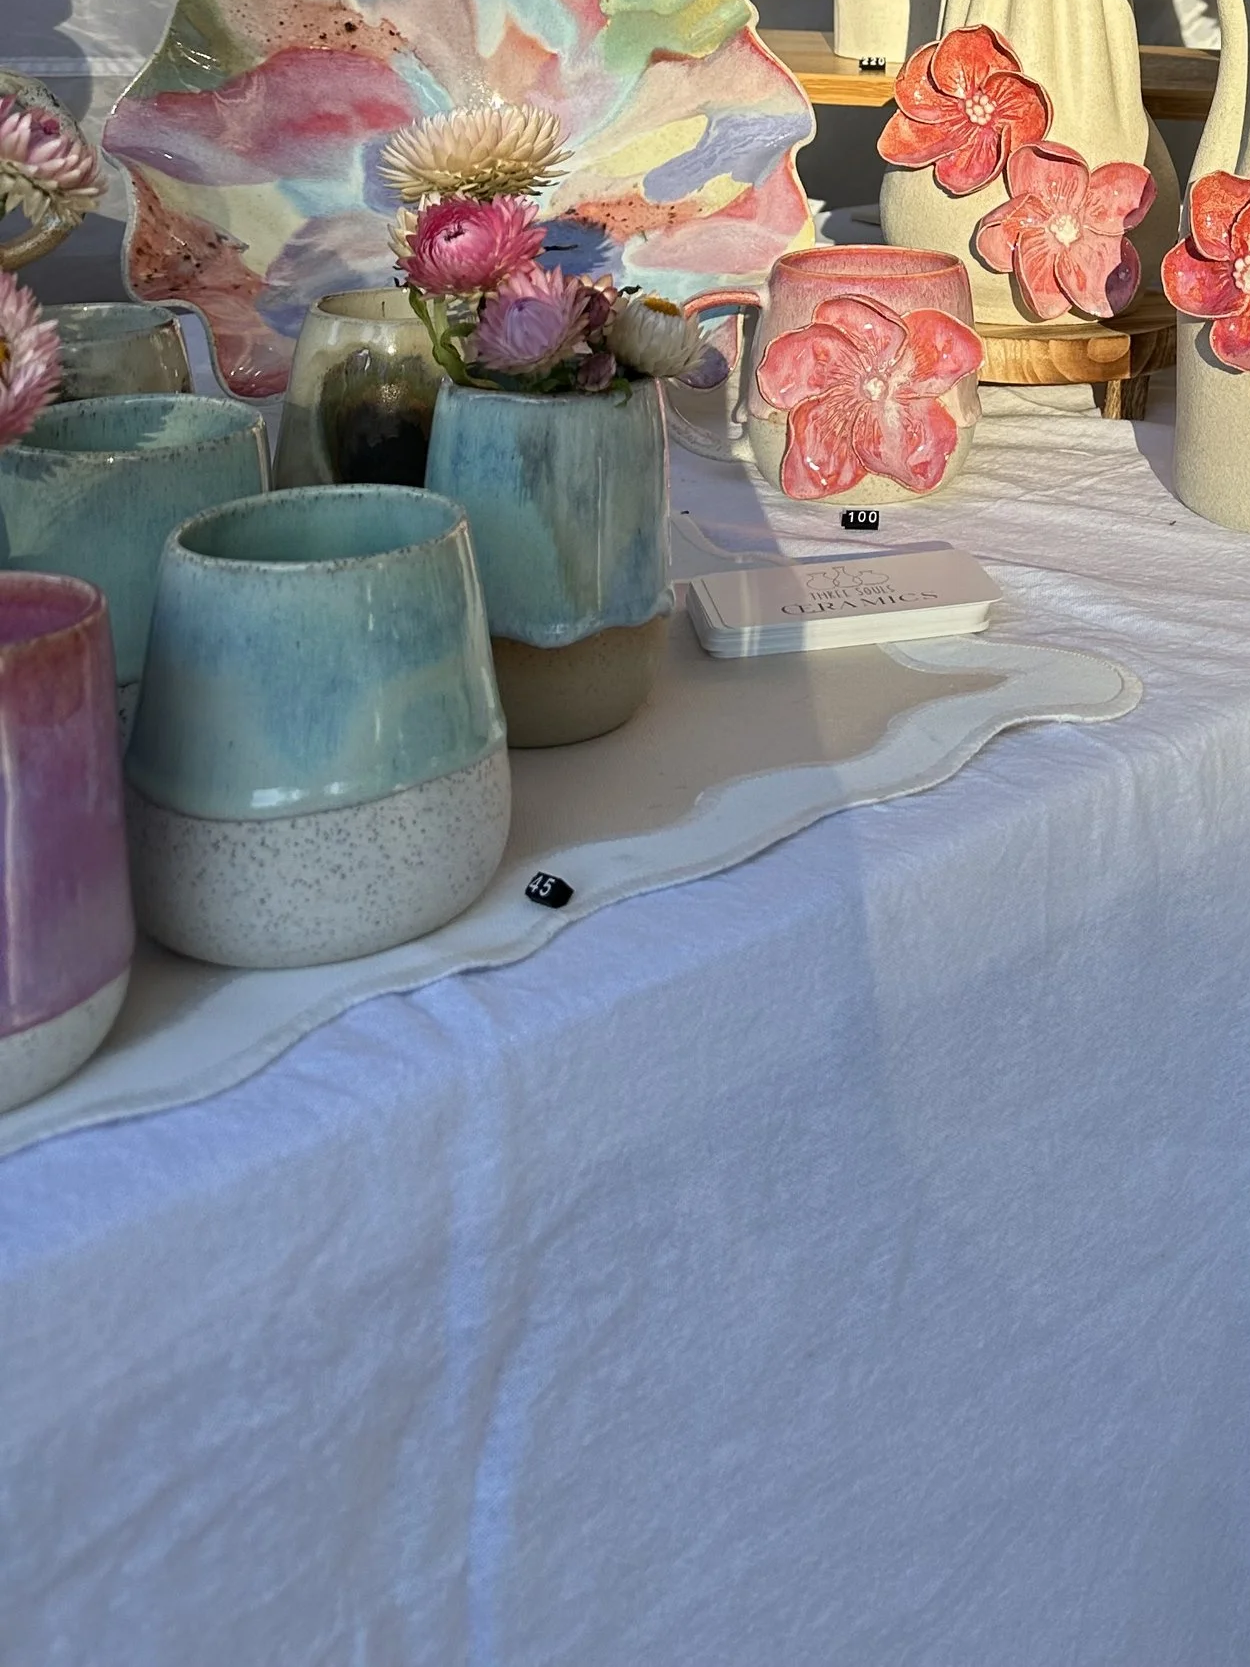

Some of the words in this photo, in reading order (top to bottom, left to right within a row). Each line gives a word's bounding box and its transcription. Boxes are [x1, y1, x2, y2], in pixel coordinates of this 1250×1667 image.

[848, 511, 877, 523] 100
[810, 588, 851, 601] THREE
[855, 584, 896, 596] SOULS
[529, 875, 556, 897] 45
